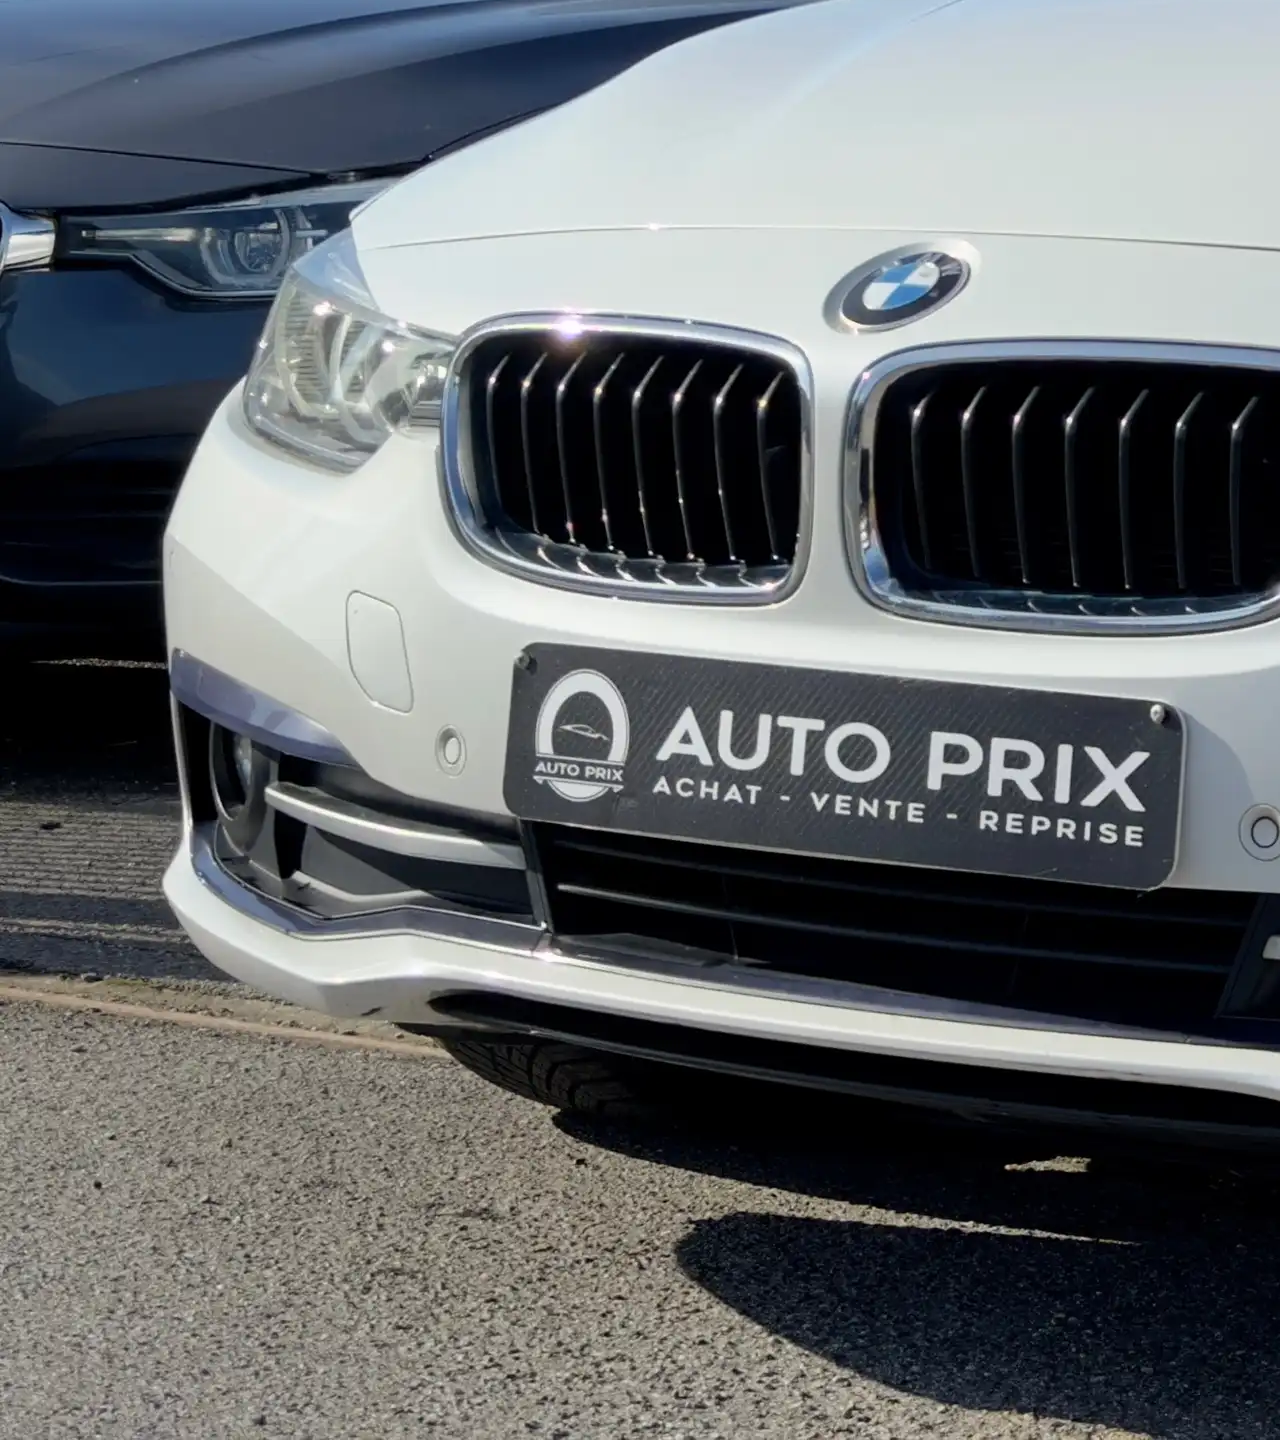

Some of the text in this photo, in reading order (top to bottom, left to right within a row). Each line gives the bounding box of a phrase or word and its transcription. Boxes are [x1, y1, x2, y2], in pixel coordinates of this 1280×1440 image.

[535, 761, 624, 782] AUTO PRIX
[655, 706, 1150, 812] AUTO PRIX
[652, 775, 762, 806] ACHAT
[810, 791, 926, 824] VENTE
[979, 810, 1144, 847] REPRISE
